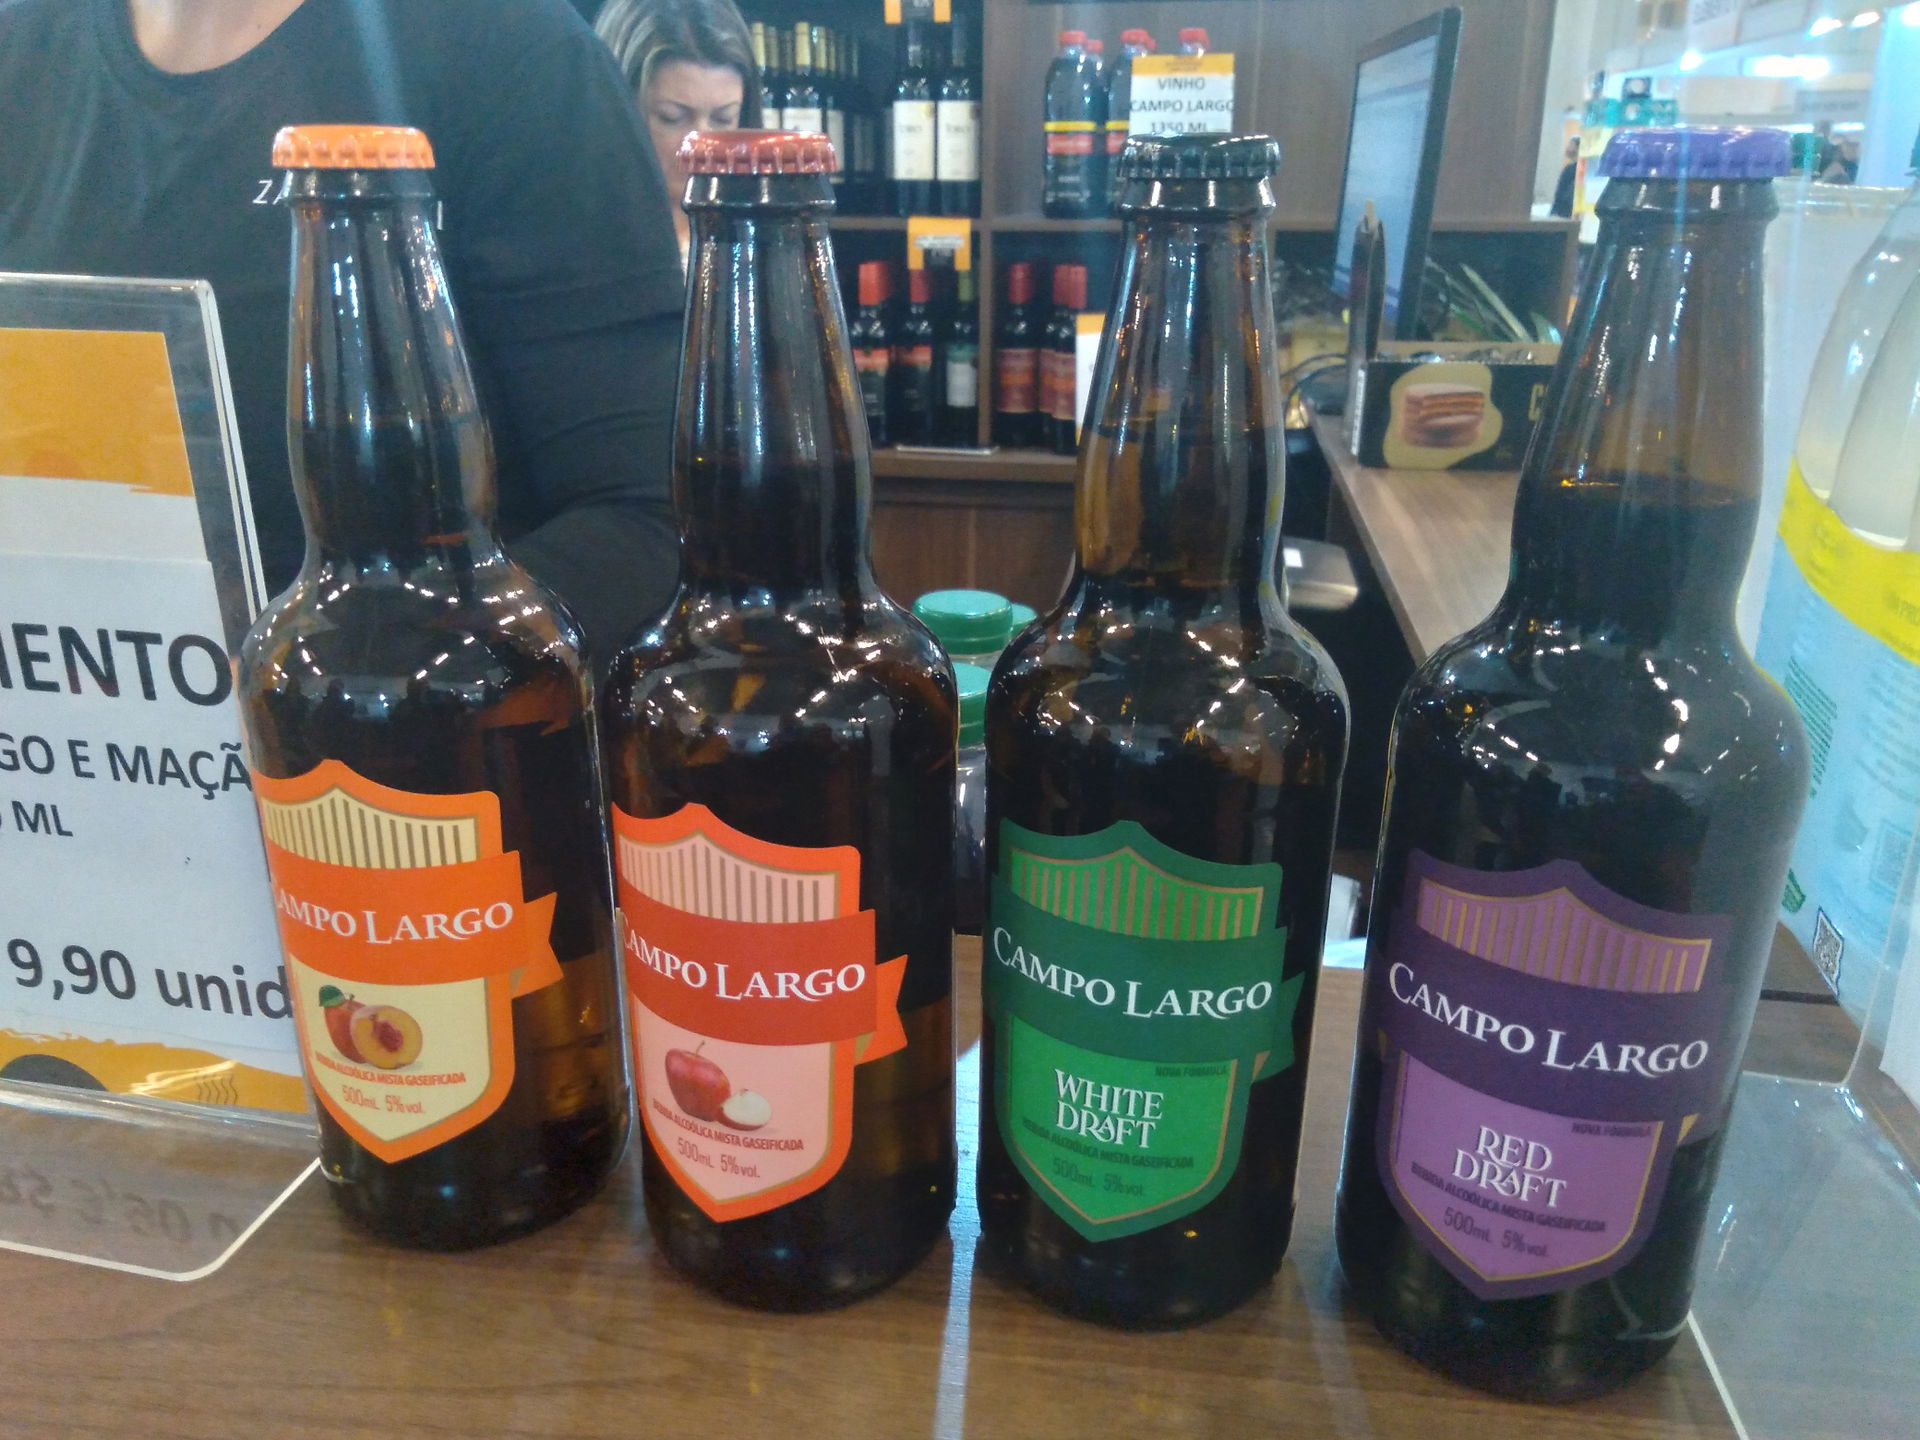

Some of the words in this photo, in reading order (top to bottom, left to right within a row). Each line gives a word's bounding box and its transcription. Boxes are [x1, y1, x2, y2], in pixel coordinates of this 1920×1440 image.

[1131, 100, 1183, 112] CAMPO
[1158, 77, 1206, 90] VINHO
[67, 739, 96, 779] E
[106, 742, 253, 800] MAÇÃ
[12, 800, 73, 837] ML
[278, 888, 357, 936] AMPO
[363, 902, 514, 944] LARGO
[7, 938, 136, 1000] 9,90
[714, 962, 866, 1002] LARGO
[994, 926, 1115, 1006] CAMPO
[1123, 980, 1272, 1019] LARGO
[1389, 962, 1535, 1054] CAMPO
[1542, 1029, 1709, 1078] LARGO
[1055, 1069, 1164, 1120] WHITE
[714, 1130, 741, 1147] MISTA
[742, 1136, 804, 1151] GASEIFICADA
[1056, 1100, 1156, 1148] DRAFT
[677, 1137, 714, 1169] 500mL
[1477, 1125, 1553, 1173] RED
[1452, 1148, 1568, 1208] DRAFT
[1443, 1206, 1492, 1243] 500mL
